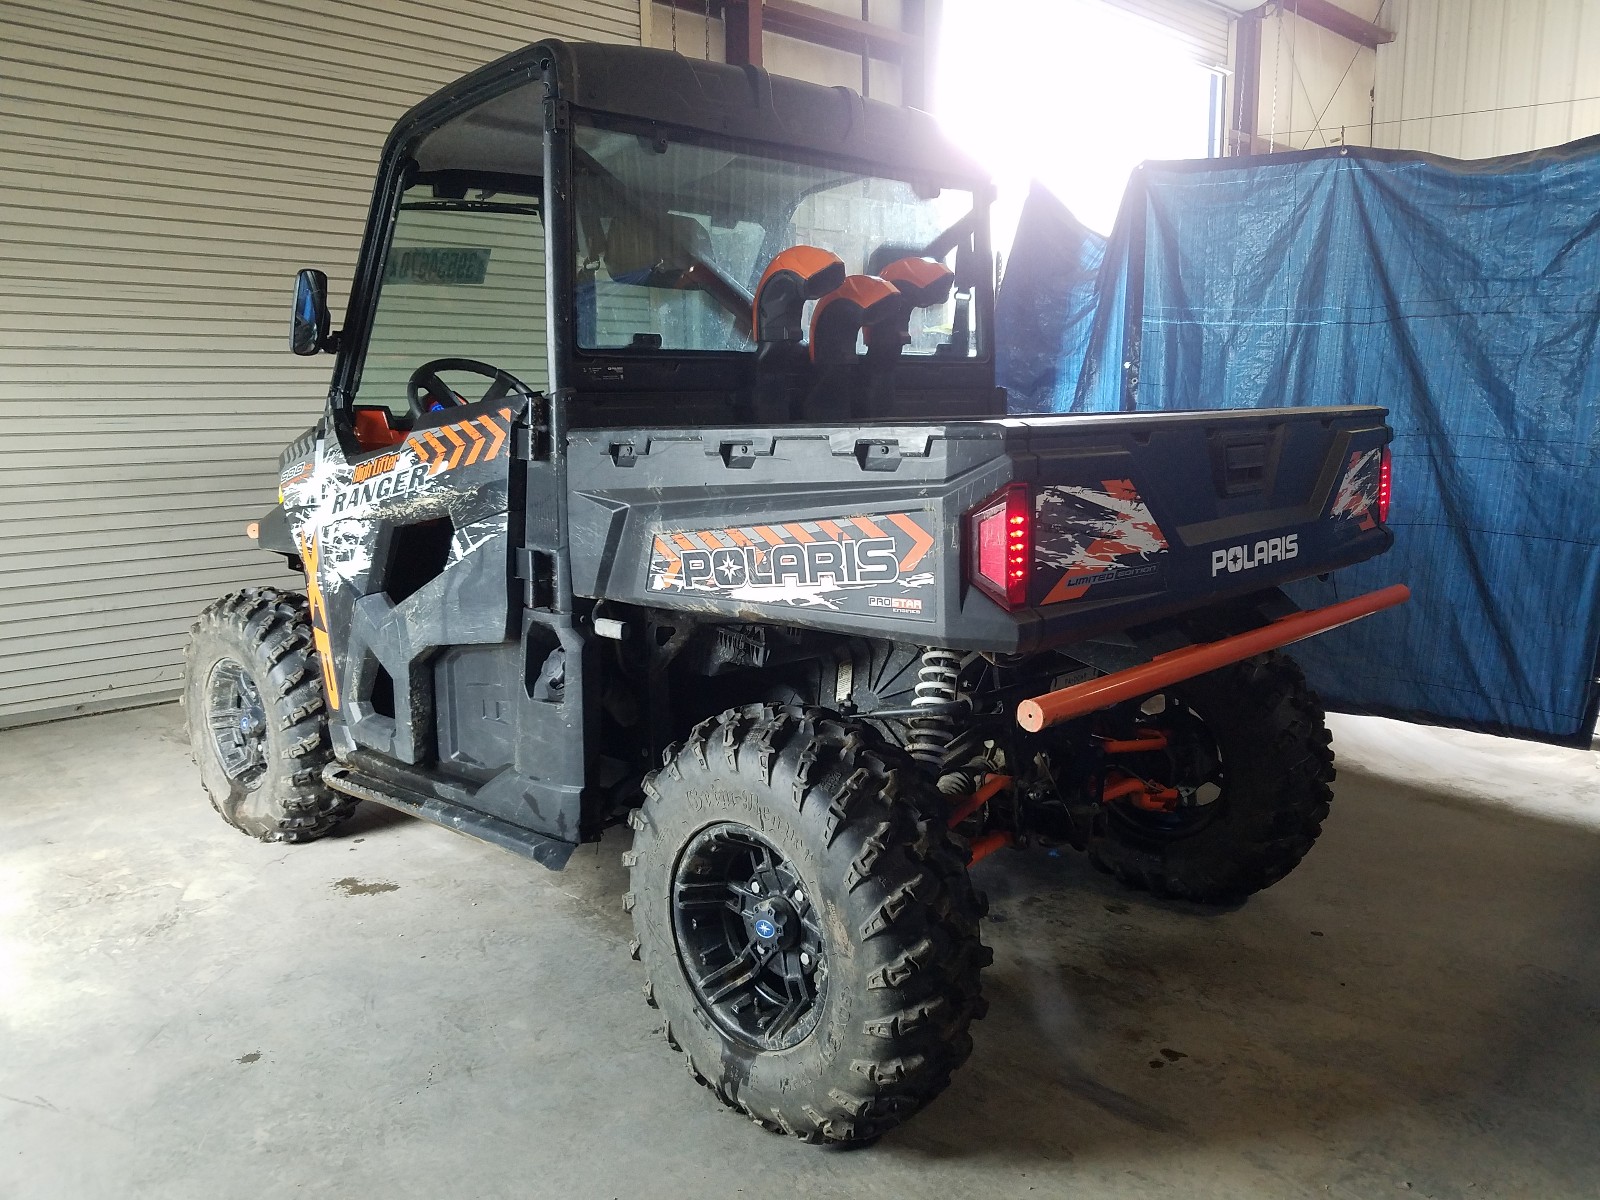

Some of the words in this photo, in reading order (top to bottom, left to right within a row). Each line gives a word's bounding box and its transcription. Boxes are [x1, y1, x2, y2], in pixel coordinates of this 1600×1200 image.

[372, 453, 401, 476] Lifter
[332, 463, 430, 515] RANGER
[680, 536, 900, 590] POLARIS
[1212, 533, 1299, 577] POLARIS
[1067, 571, 1115, 587] LIMITED
